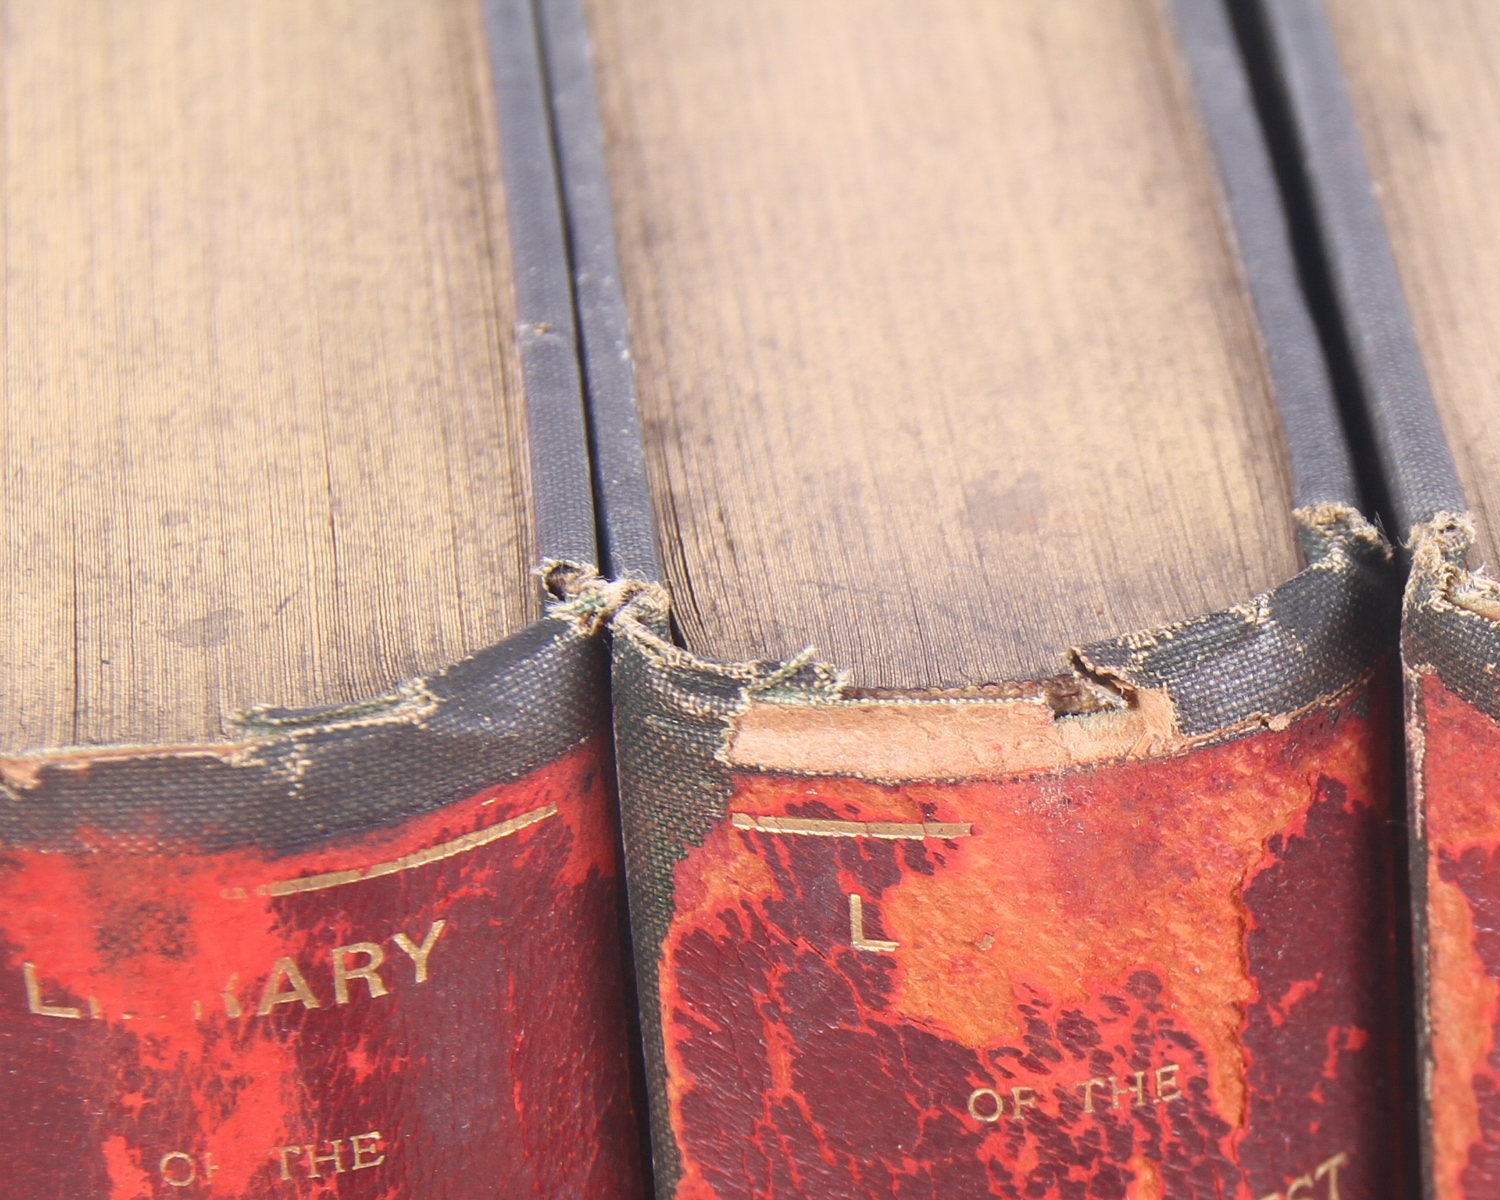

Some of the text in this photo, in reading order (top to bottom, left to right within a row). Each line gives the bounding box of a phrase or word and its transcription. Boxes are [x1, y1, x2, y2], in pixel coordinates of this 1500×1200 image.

[23, 920, 446, 1020] LARY
[967, 1064, 1181, 1122] OF THE
[277, 1131, 386, 1181] THE
